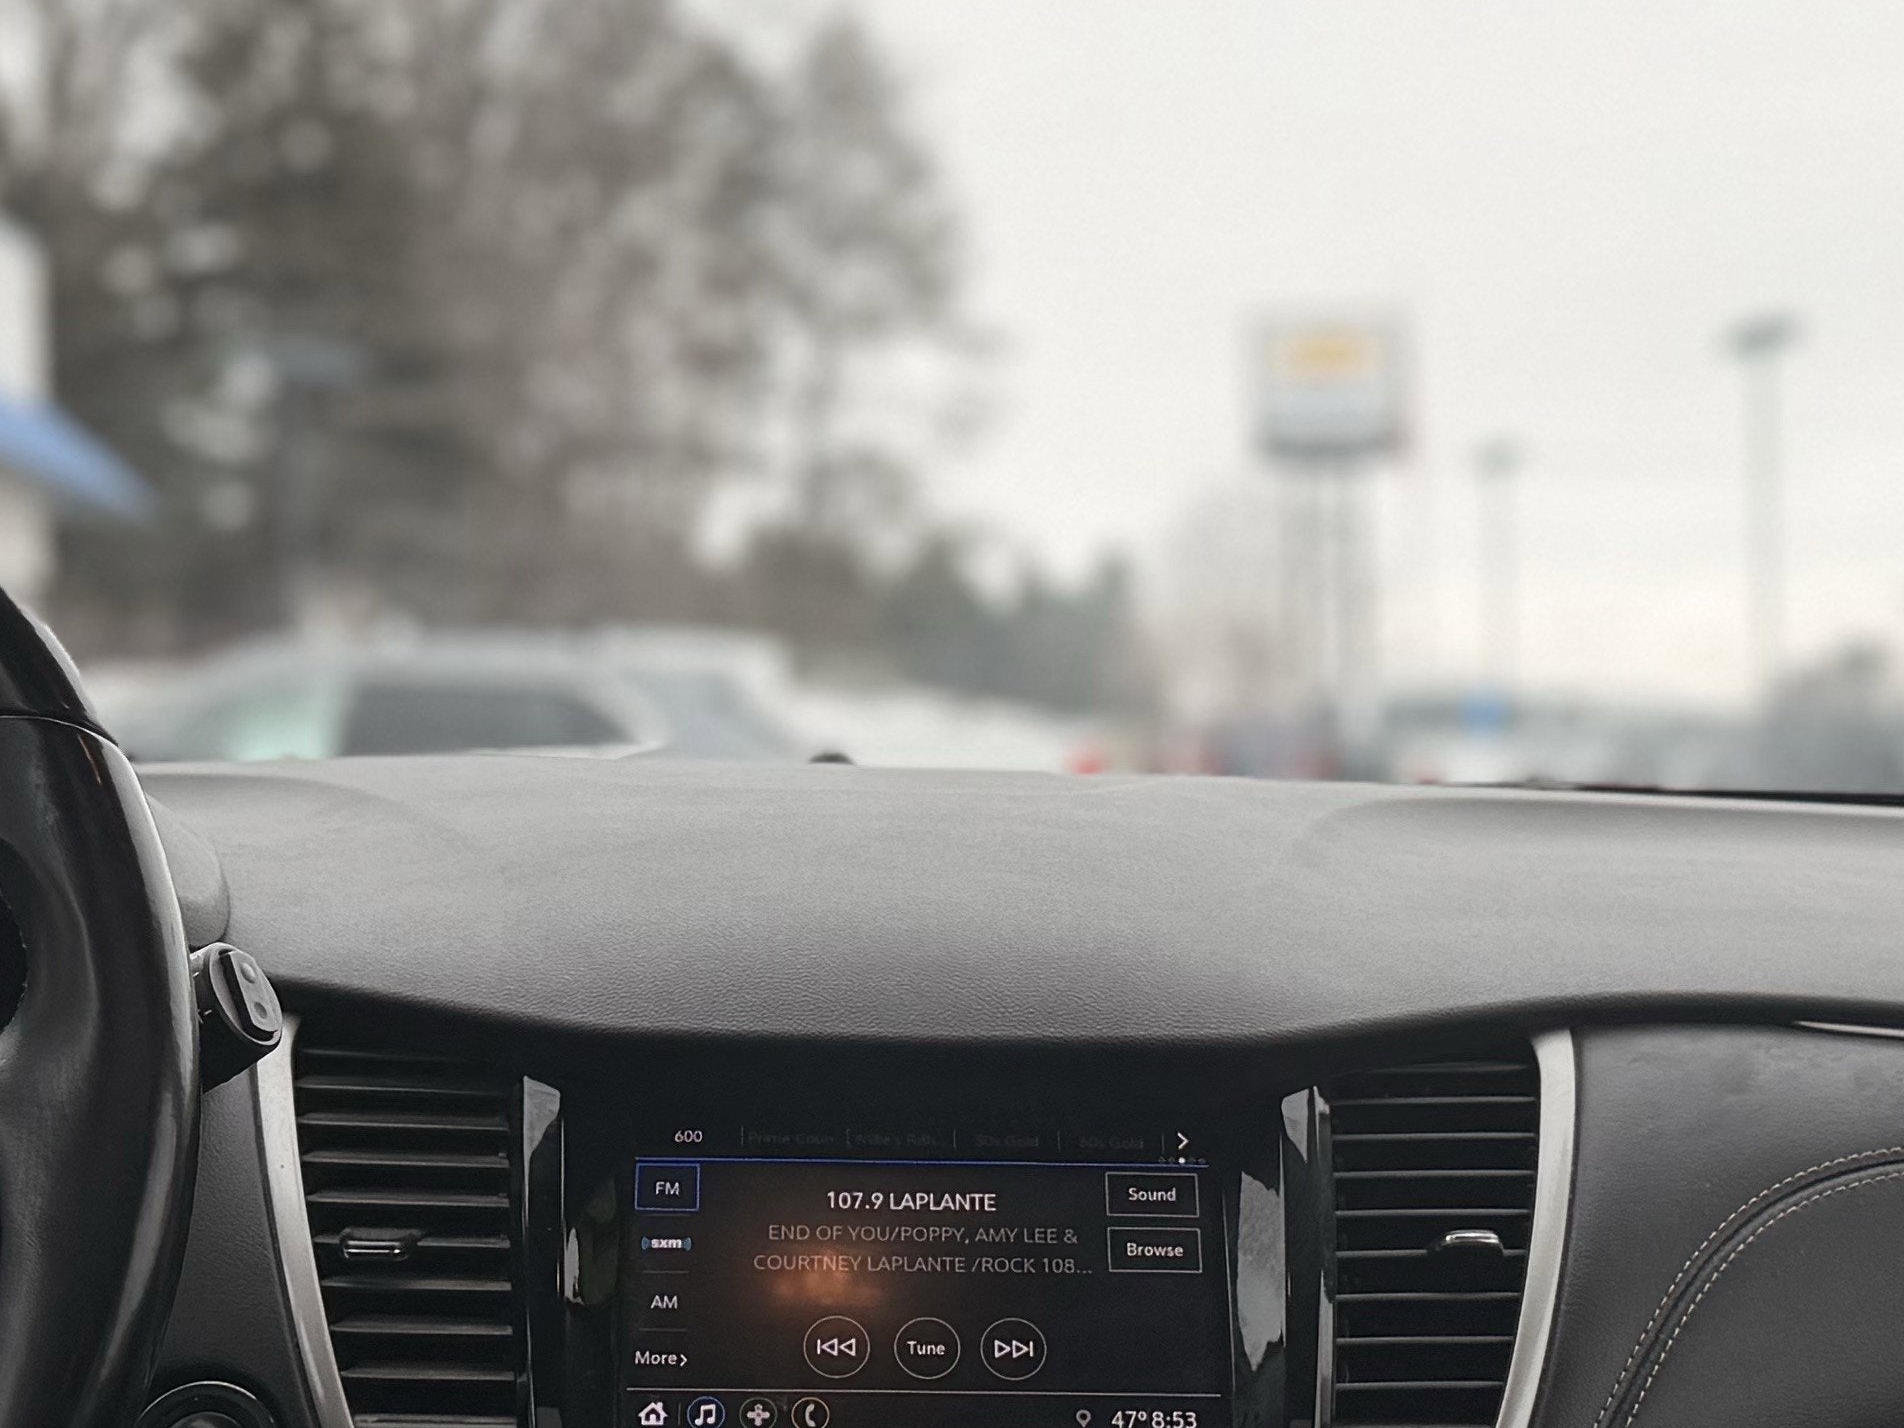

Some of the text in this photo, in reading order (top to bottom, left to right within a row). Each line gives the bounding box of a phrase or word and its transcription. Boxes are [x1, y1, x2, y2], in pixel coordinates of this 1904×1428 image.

[673, 1129, 704, 1144] 600
[655, 1181, 680, 1196] FM
[1128, 1186, 1177, 1202] Sound
[826, 1191, 997, 1211] 107.9 LAPLANTE
[768, 1224, 1080, 1245] END OF YOU/POPPY, AMY LEE &
[1126, 1241, 1185, 1257] Browse
[753, 1254, 861, 1272] COURTNEY
[867, 1256, 966, 1273] LAPLANTE
[971, 1257, 1037, 1274] /ROCK
[650, 1294, 678, 1309] AM
[906, 1340, 946, 1356] Tune
[634, 1350, 677, 1365] More
